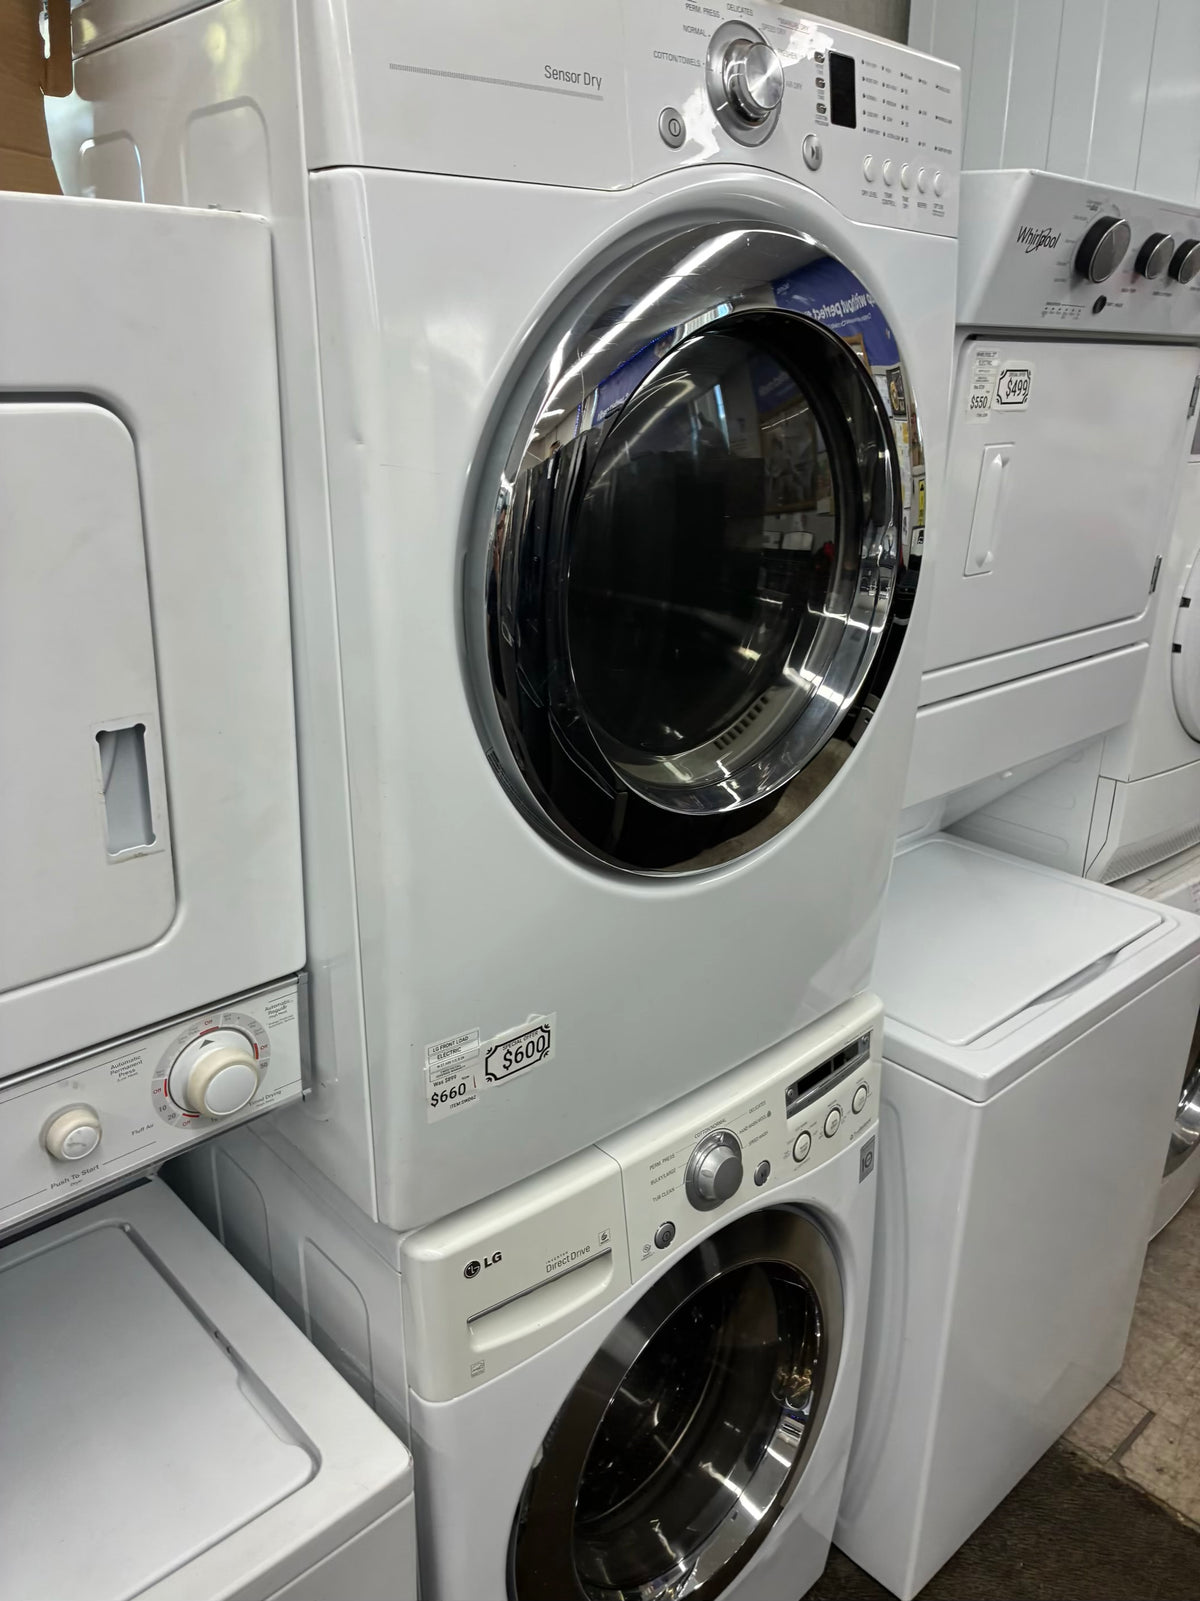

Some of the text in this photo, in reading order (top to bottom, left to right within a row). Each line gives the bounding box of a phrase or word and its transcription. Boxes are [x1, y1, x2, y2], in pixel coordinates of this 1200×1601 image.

[682, 24, 707, 38] NORMAL
[544, 64, 603, 91] Sensor Dry
[1016, 225, 1062, 254] Whirlpool
[1005, 377, 1029, 400] $499
[970, 395, 988, 410] $550
[502, 1030, 539, 1051] SPECIAL OFFER
[110, 1055, 141, 1070] Automatic
[502, 1035, 546, 1070] $600
[110, 1059, 143, 1076] Permanent
[430, 1082, 467, 1108] $660
[50, 1178, 70, 1190] Push
[81, 1164, 100, 1176] Start
[484, 1251, 502, 1269] LG
[545, 1245, 591, 1273] Direct Drive
